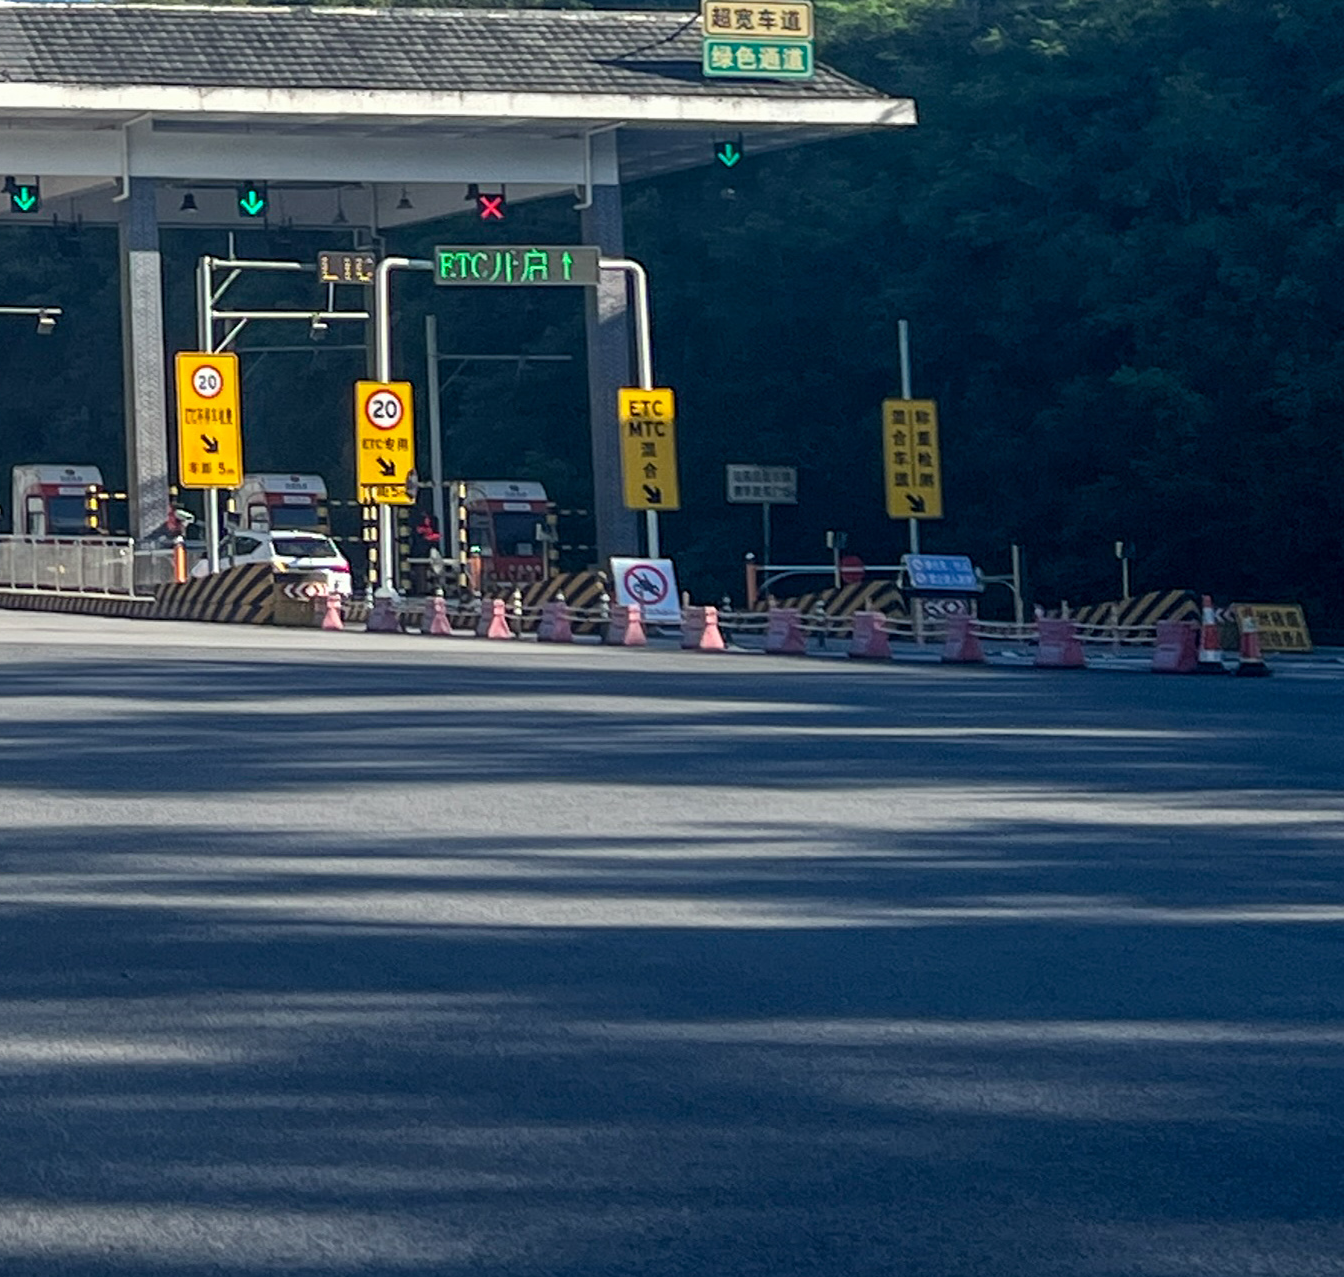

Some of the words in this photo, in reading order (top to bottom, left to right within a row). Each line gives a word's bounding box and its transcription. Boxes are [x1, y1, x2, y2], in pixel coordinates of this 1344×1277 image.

[711, 7, 802, 31] 超宽车道
[711, 45, 805, 70] 绿色通道
[198, 375, 217, 390] 20
[373, 400, 397, 419] 20
[629, 400, 664, 416] ETC
[629, 422, 665, 437] MTC
